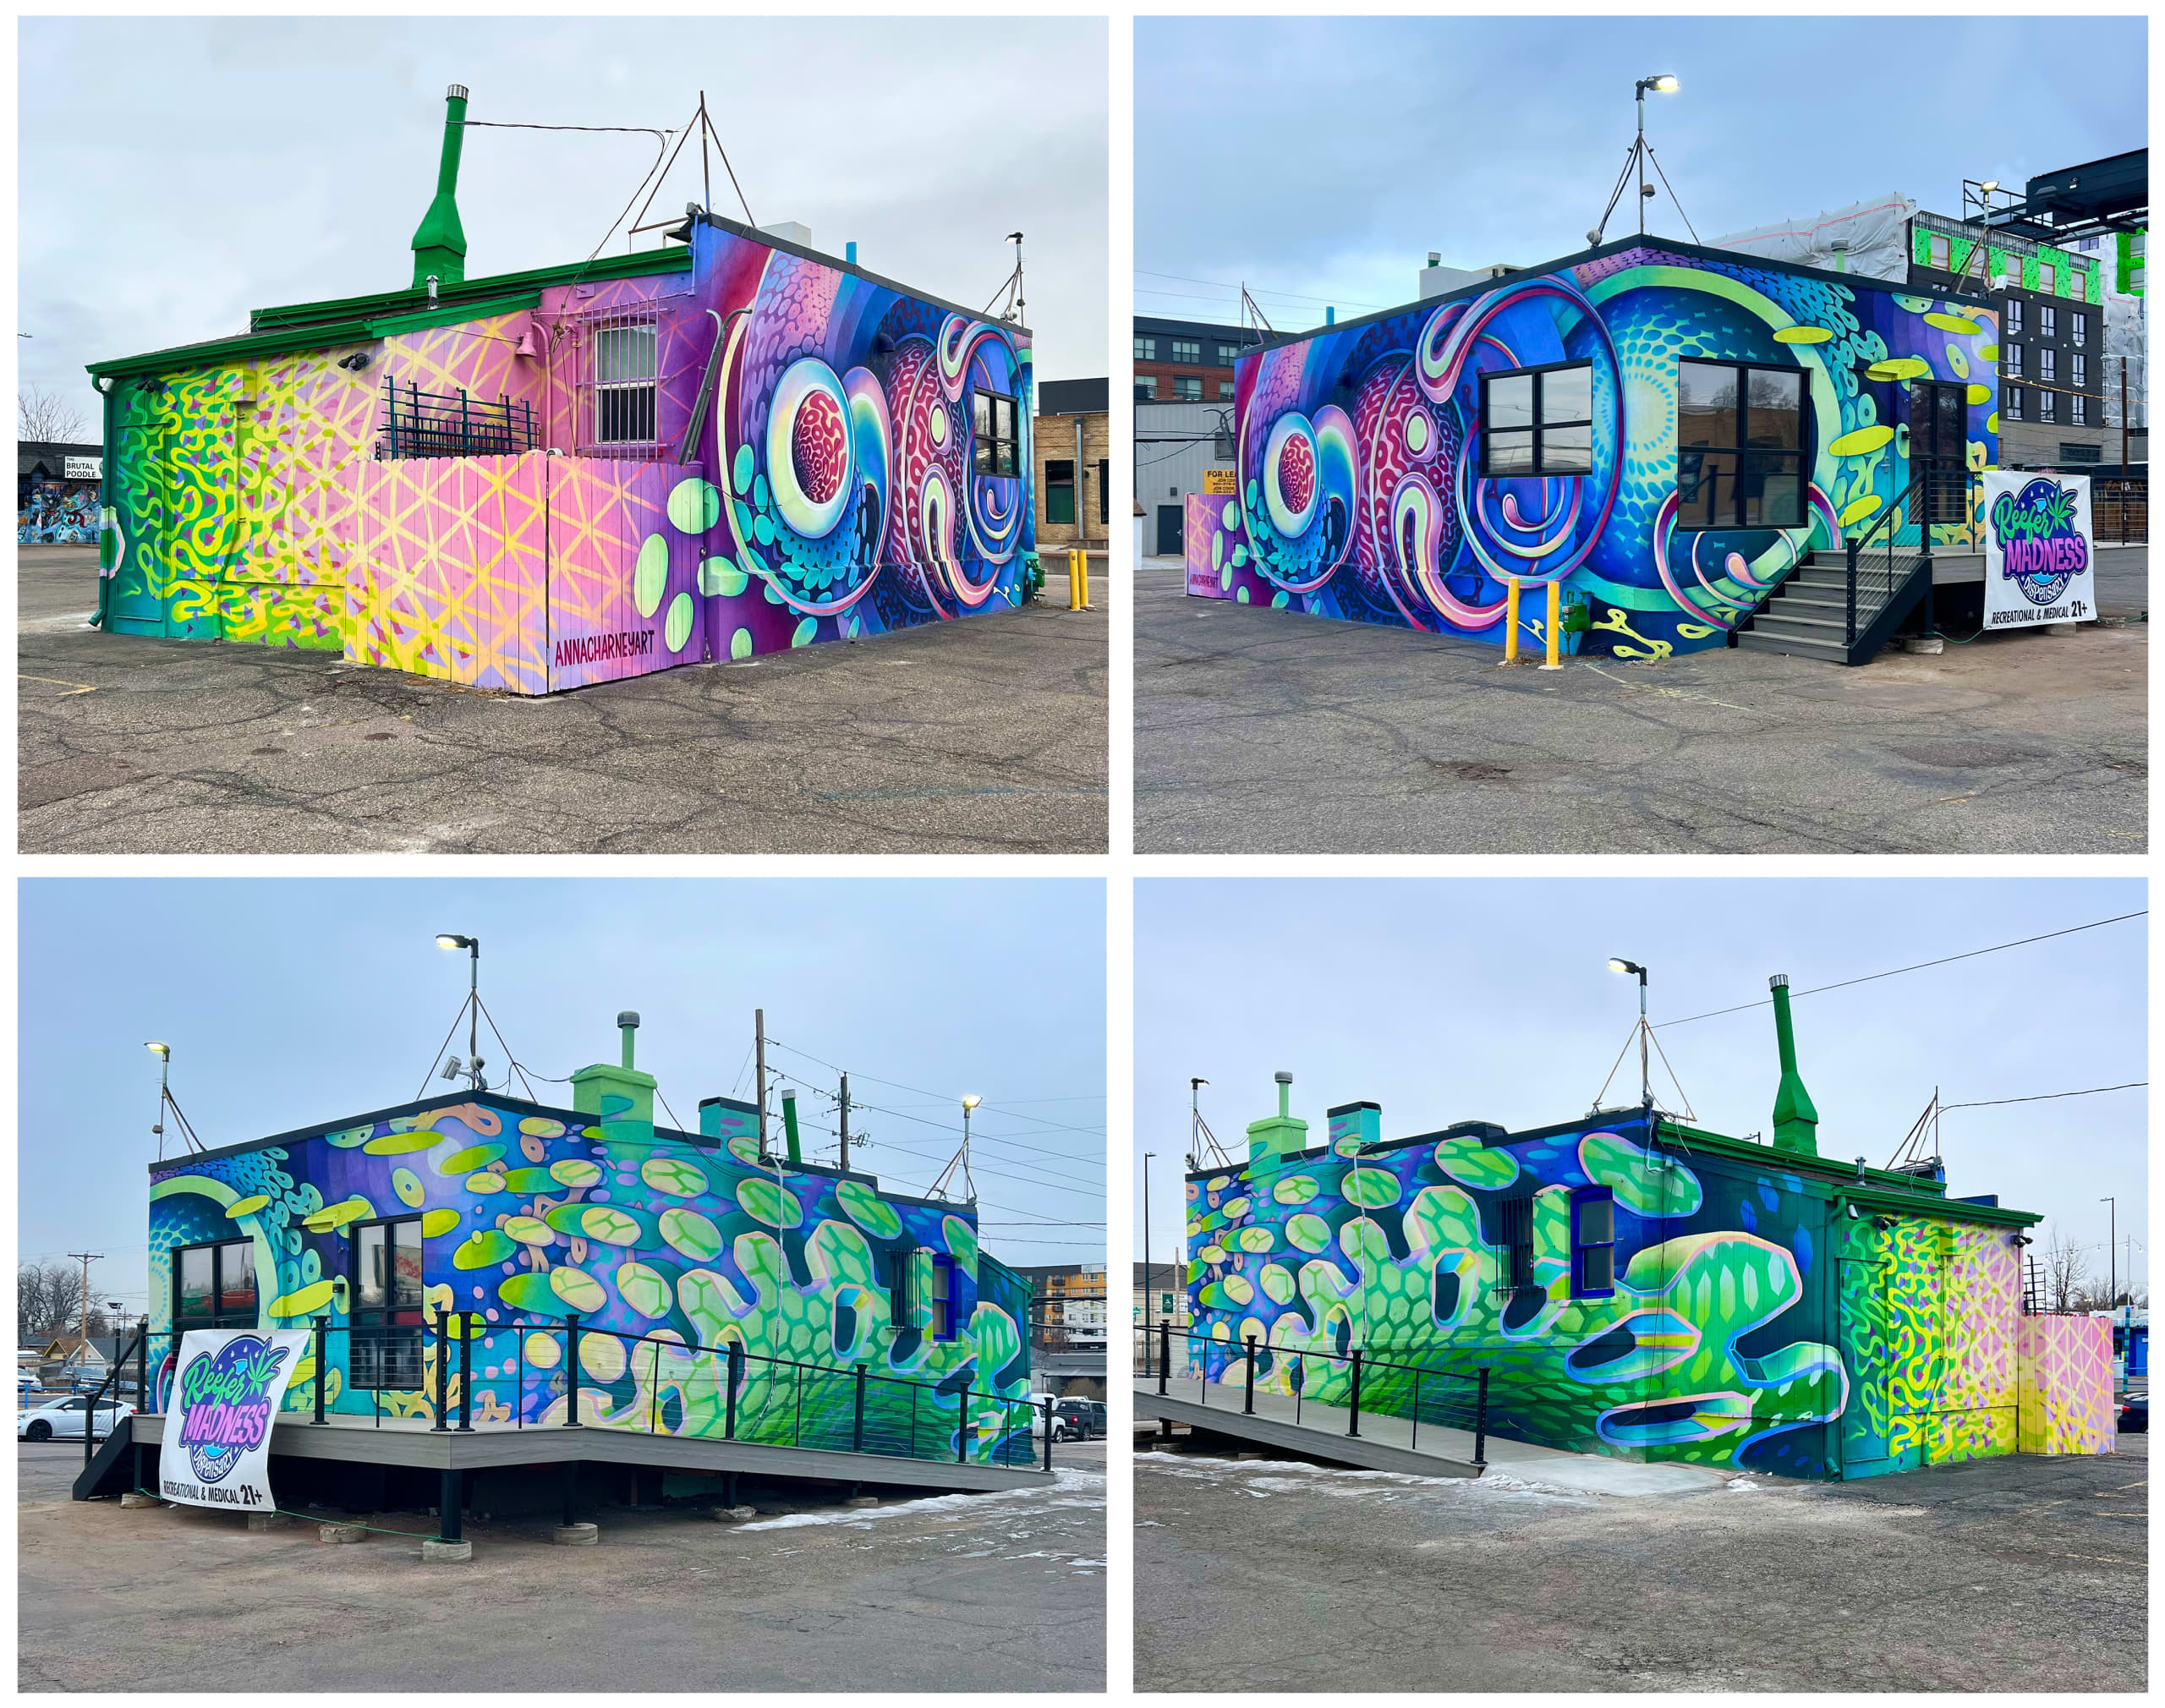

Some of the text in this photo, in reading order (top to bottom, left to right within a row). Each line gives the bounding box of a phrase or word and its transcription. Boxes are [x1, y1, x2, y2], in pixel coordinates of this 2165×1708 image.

[1994, 496, 2054, 545] Reefer
[2005, 536, 2086, 574] MADNESS
[1992, 600, 2088, 624] RECREATIONAL & MEDICAL 21+
[555, 630, 655, 668] ANNACHARNEYART
[184, 1357, 250, 1411] Reefer
[183, 1402, 268, 1443] MADNESS
[163, 1481, 263, 1505] RECREATIONAL & MEDICAL 21+
